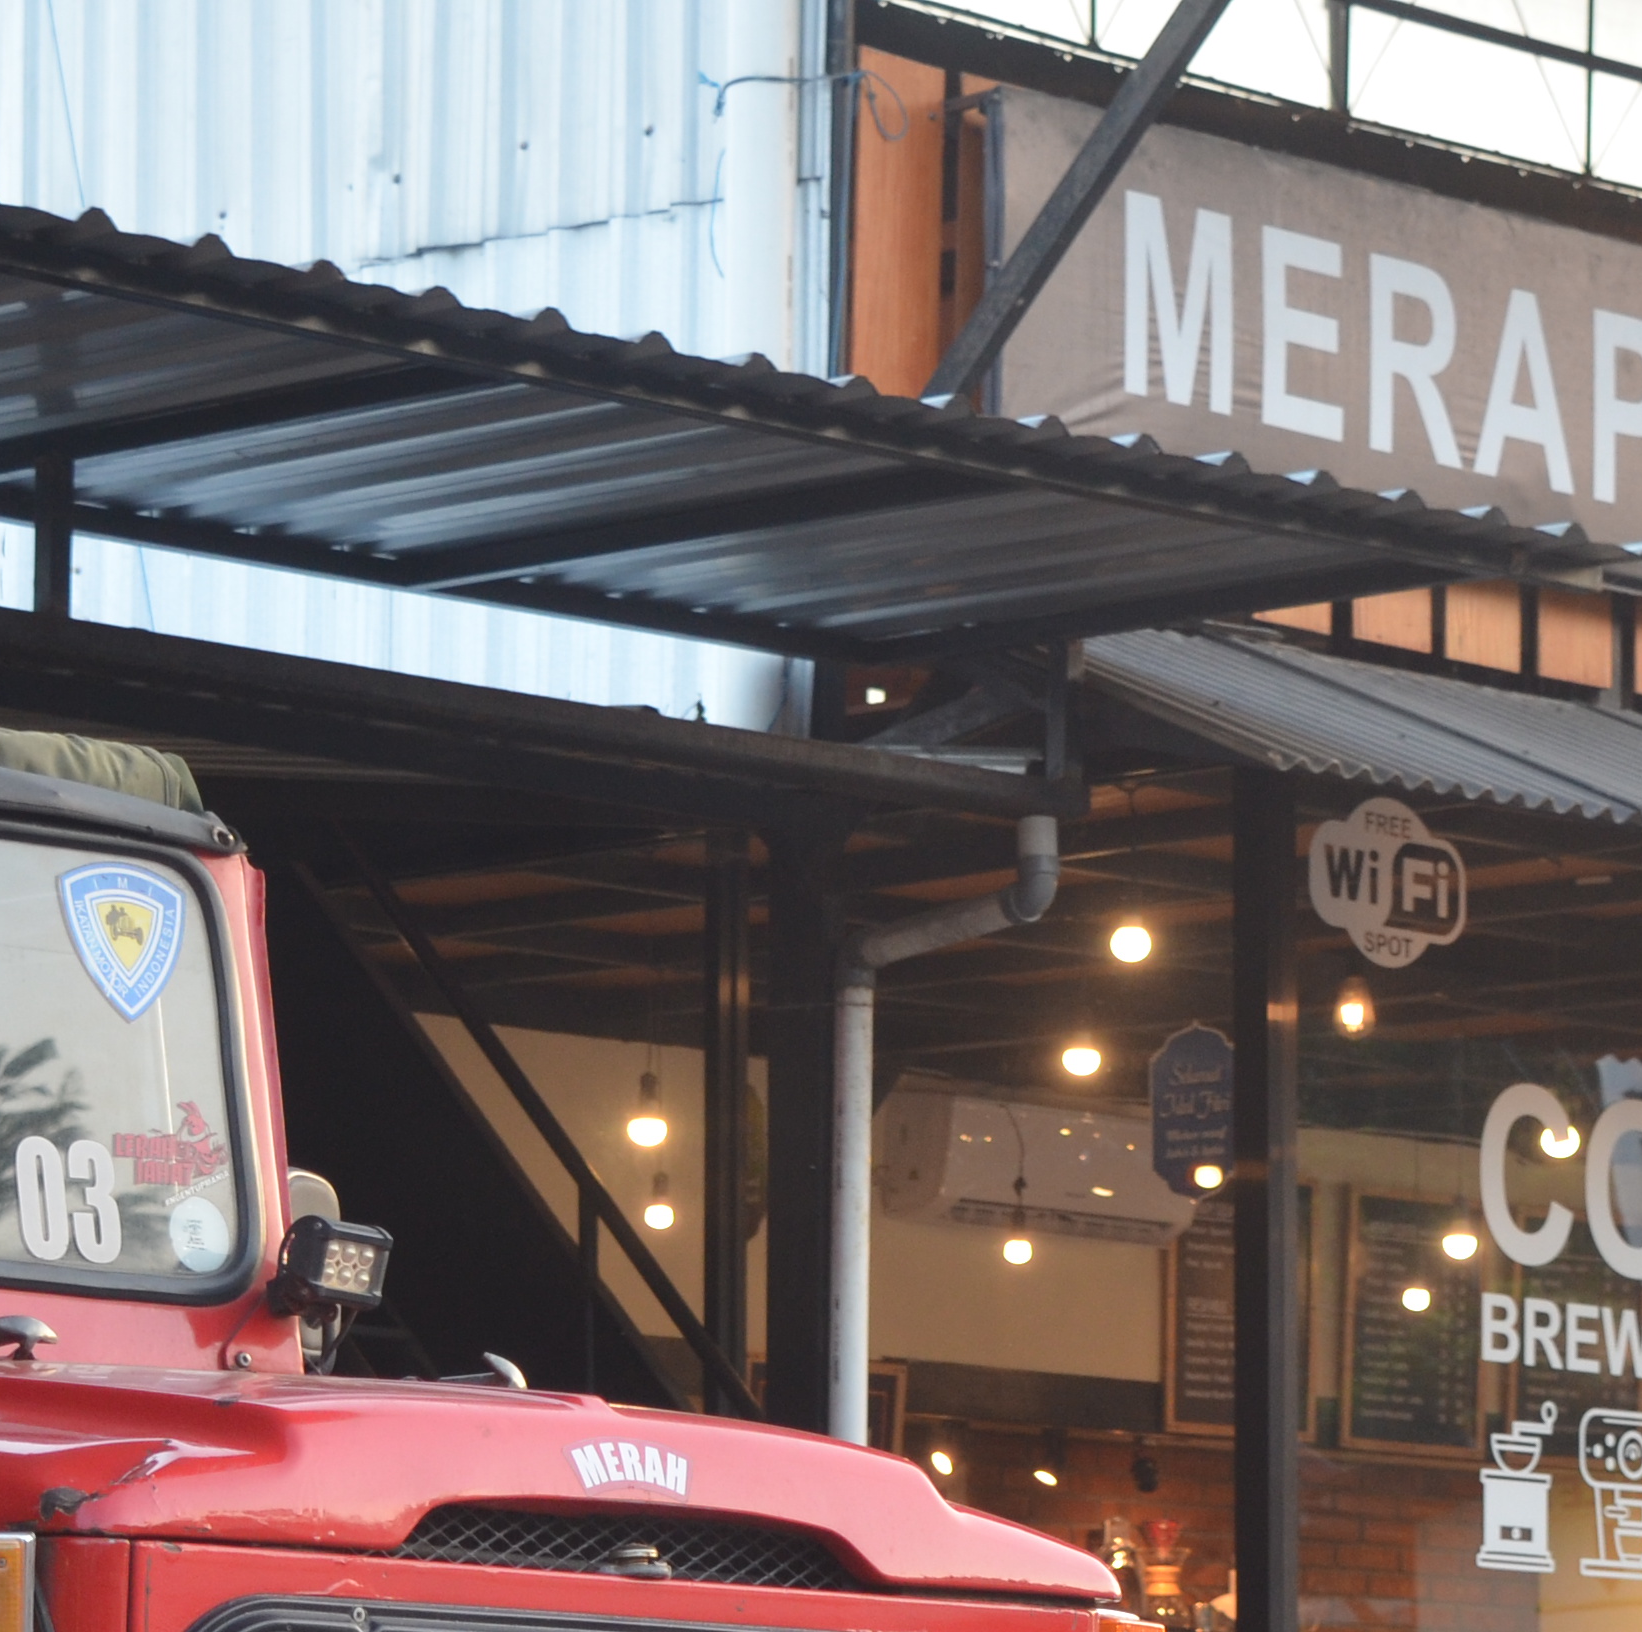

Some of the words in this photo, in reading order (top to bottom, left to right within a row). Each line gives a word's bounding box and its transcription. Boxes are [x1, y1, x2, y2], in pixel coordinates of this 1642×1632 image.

[1363, 811, 1413, 841] FREE
[73, 898, 99, 956] IKATAN
[92, 950, 129, 999] MOTOR
[134, 907, 177, 998] INDONESIA
[1362, 932, 1414, 961] SPOT
[15, 1134, 122, 1265] 03
[570, 1441, 688, 1495] MERAH
